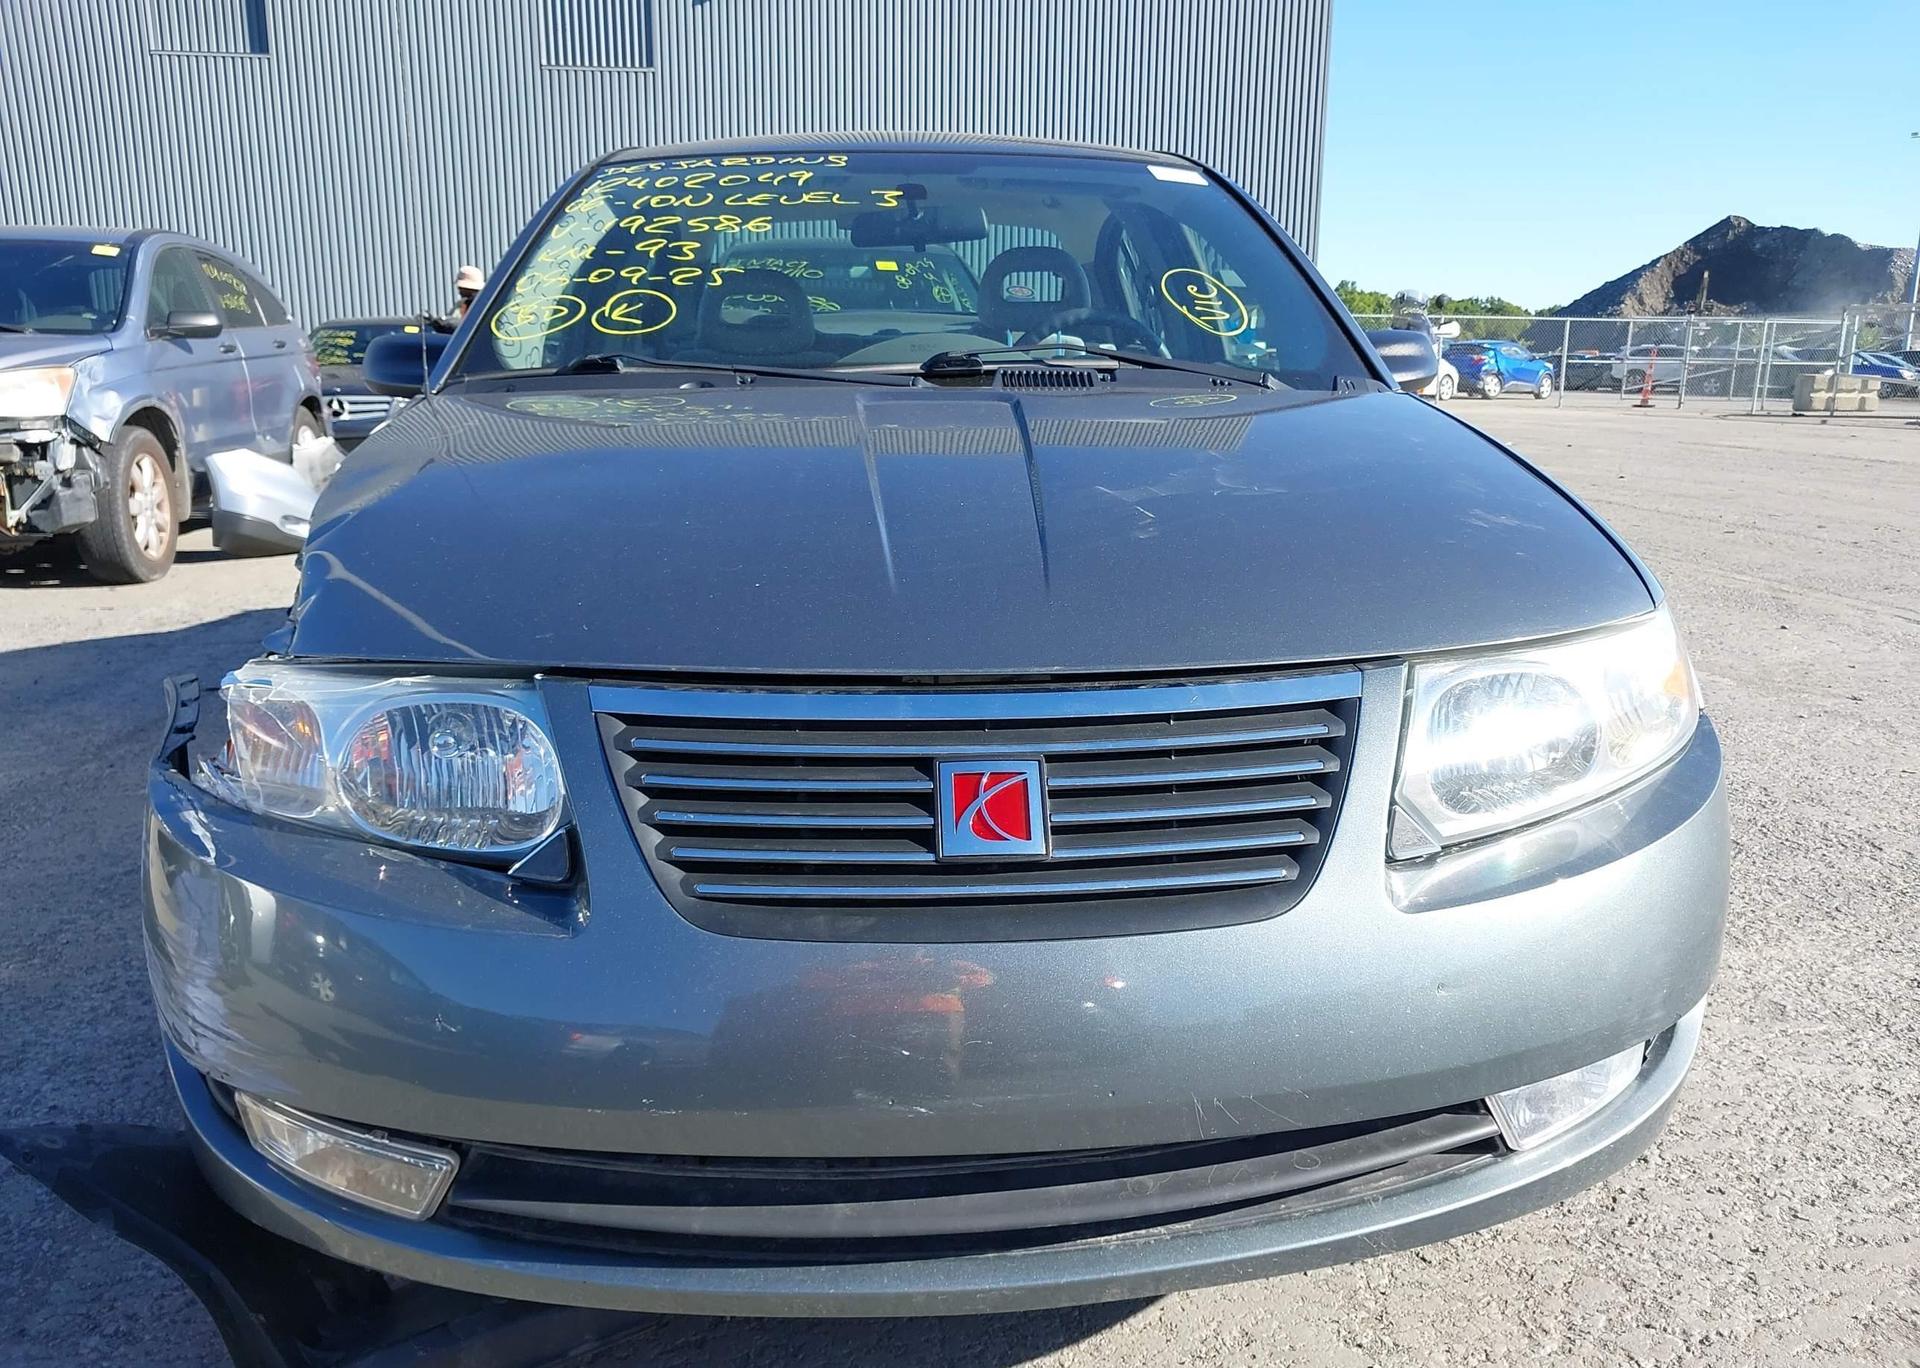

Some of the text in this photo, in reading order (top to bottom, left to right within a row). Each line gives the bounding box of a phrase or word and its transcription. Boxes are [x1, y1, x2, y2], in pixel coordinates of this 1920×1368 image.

[597, 156, 849, 179] DESJARDINS
[724, 191, 861, 206] LEVEL
[870, 189, 904, 207] 3
